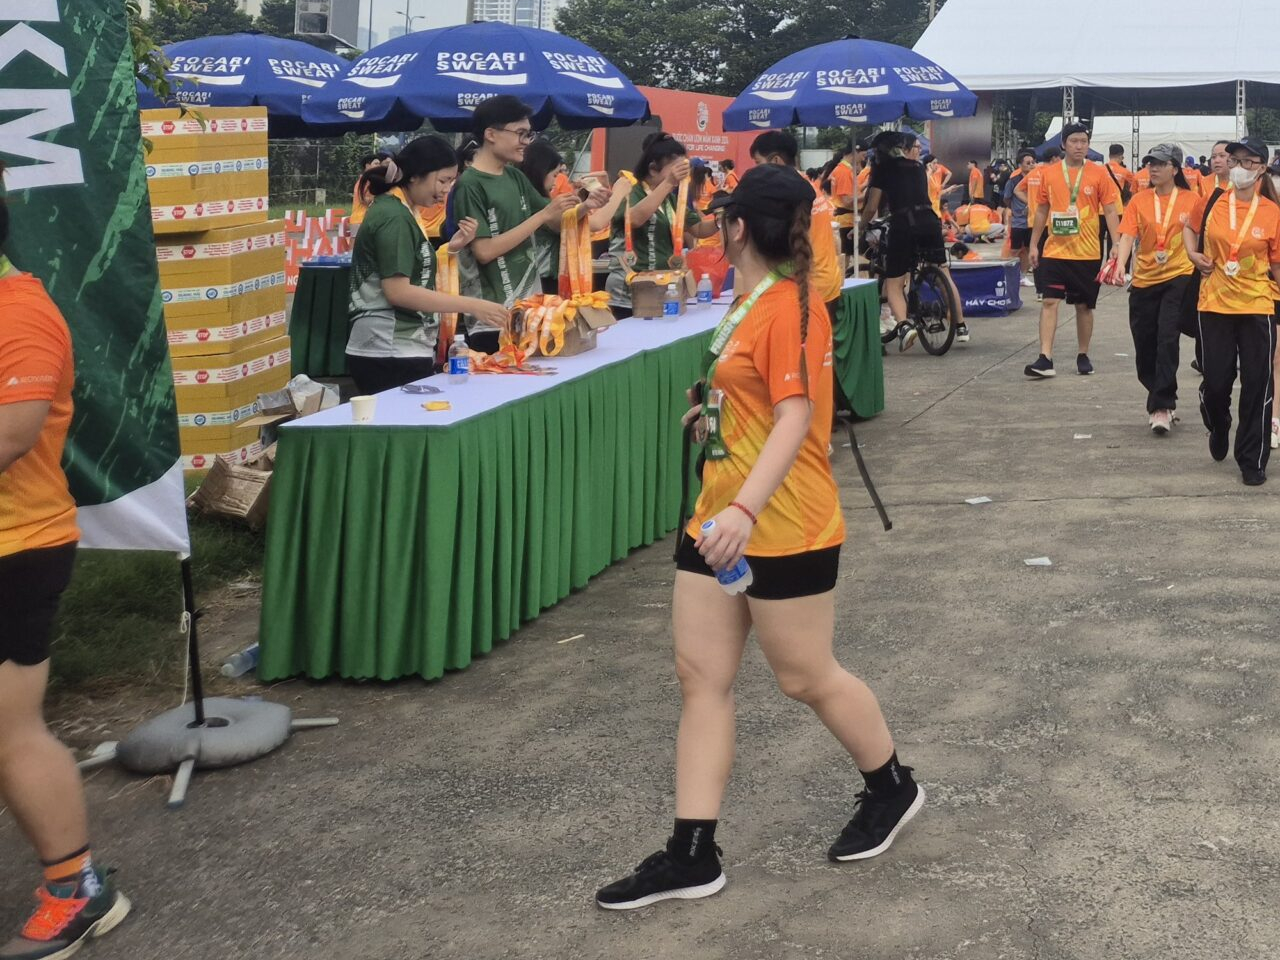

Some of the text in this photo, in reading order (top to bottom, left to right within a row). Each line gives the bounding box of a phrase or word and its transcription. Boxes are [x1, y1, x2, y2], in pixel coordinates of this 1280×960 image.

[173, 56, 251, 65] POCARI
[356, 52, 419, 66] POCARI
[437, 52, 525, 62] POCARI
[542, 51, 605, 66] POCARI
[169, 64, 241, 73] SWEAT
[268, 58, 340, 72] POCARI
[347, 63, 402, 76] SWEAT
[436, 61, 517, 71] SWEAT
[552, 61, 605, 74] SWEAT
[272, 65, 335, 78] SWEAT
[816, 67, 886, 78] POCARI
[893, 66, 943, 75] POCARI
[758, 71, 810, 82] POCARI
[816, 76, 879, 86] SWEAT
[900, 73, 944, 82] SWEAT
[752, 80, 797, 90] SWEAT
